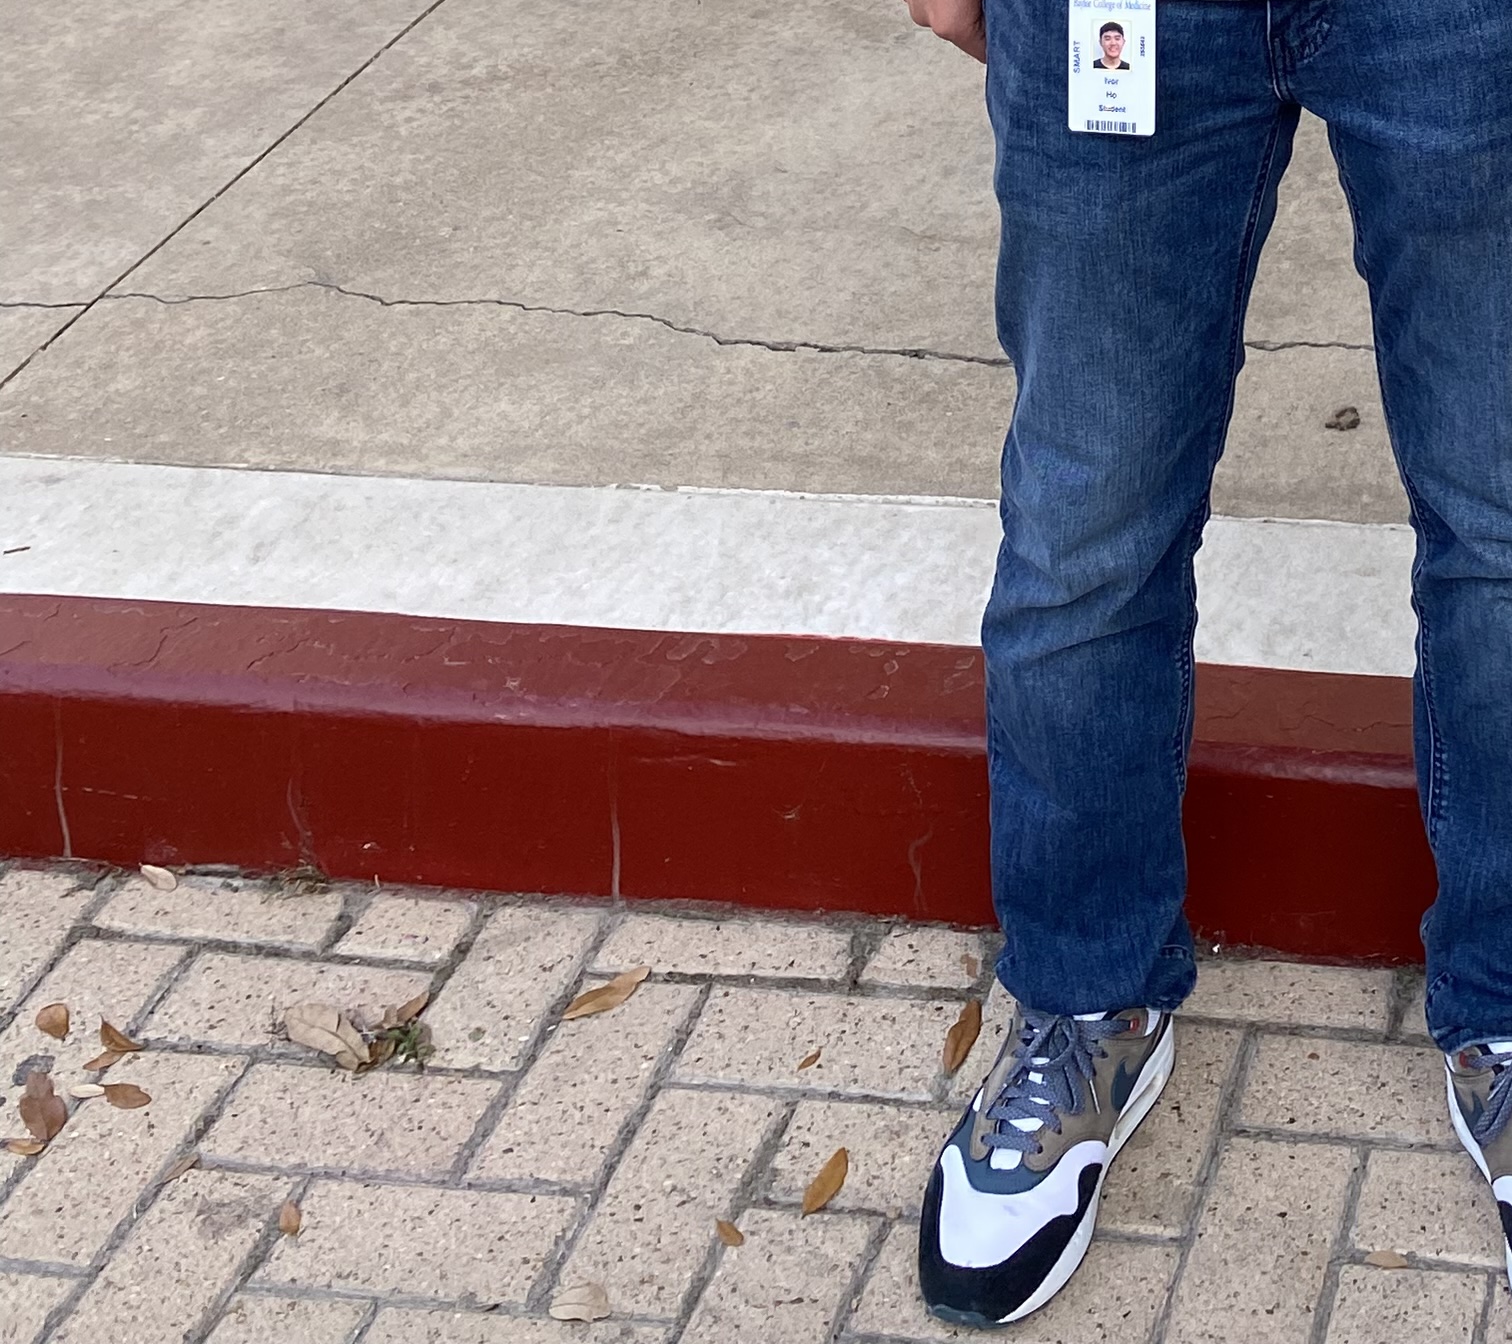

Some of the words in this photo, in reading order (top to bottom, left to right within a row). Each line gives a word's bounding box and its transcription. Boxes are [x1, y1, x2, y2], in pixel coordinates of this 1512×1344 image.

[1124, 0, 1152, 10] Medicine
[1073, 40, 1081, 74] SMART
[1098, 104, 1126, 113] Student
